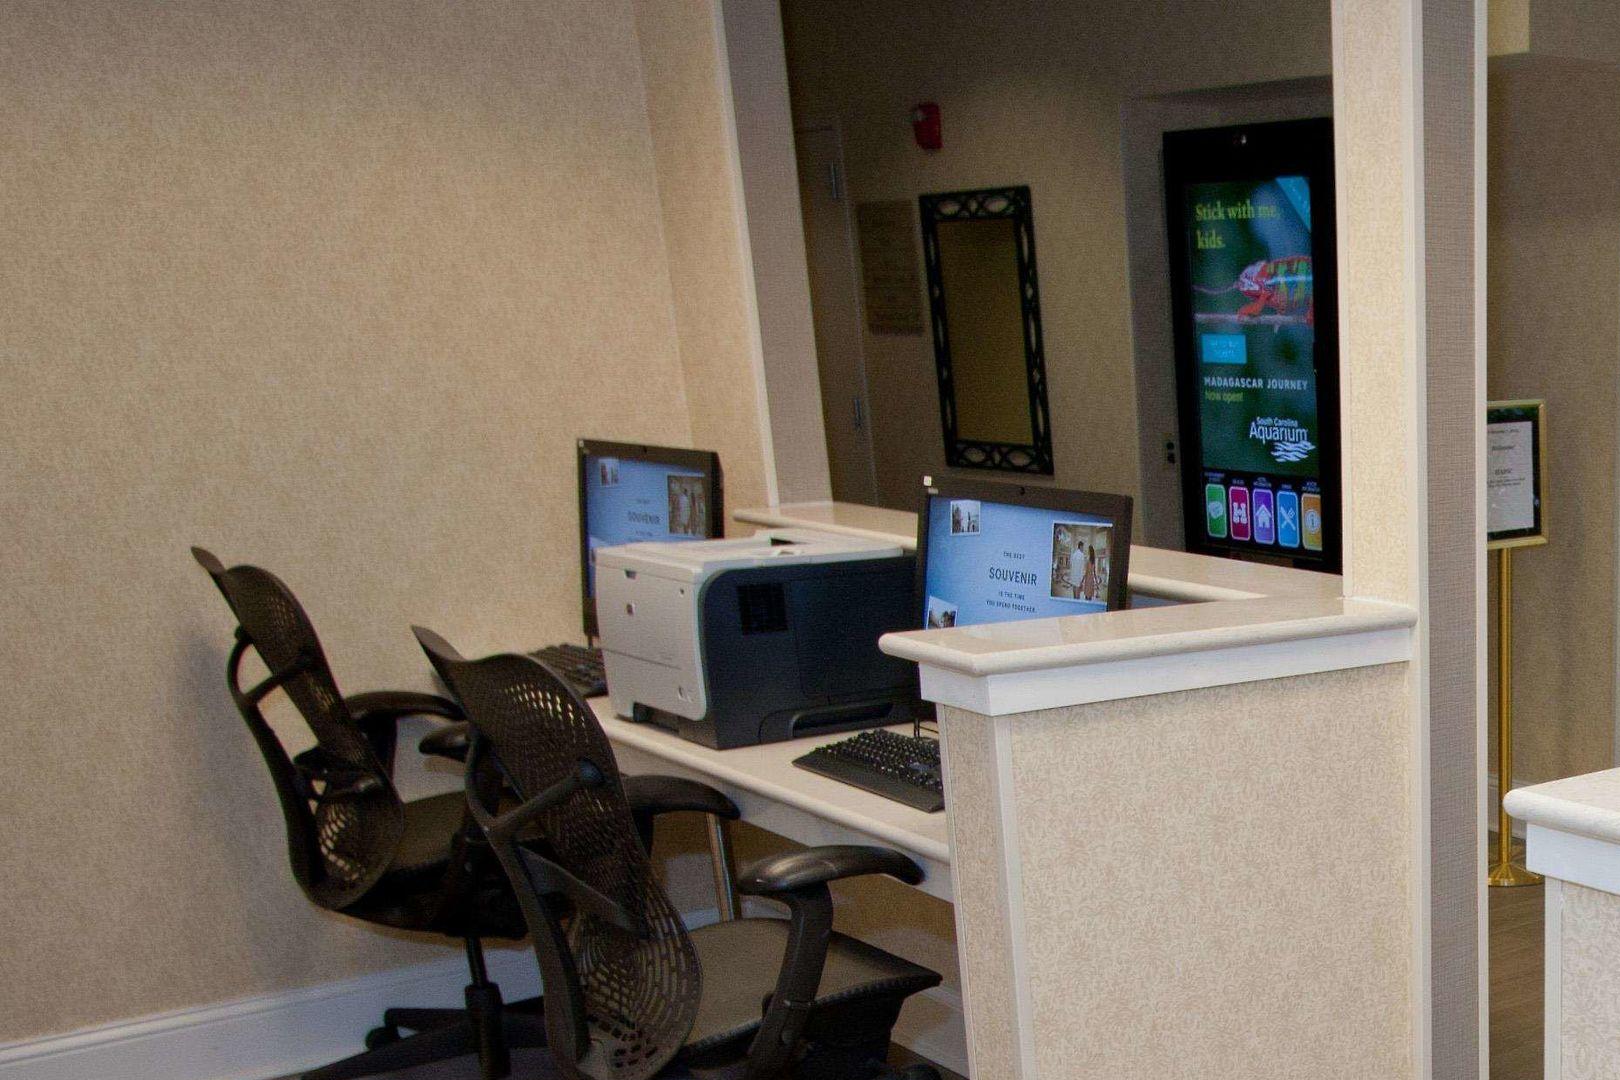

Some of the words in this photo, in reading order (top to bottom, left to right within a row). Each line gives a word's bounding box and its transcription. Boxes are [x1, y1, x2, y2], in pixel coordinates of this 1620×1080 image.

[1195, 200, 1225, 221] Stick
[1227, 199, 1255, 219] with
[1196, 229, 1226, 249] kids.
[1203, 376, 1264, 389] MADAGASCAR
[1266, 379, 1308, 390] JOURNEY
[1256, 416, 1273, 426] South
[1273, 417, 1298, 428] Carolina
[1249, 422, 1308, 445] Aquarium
[989, 567, 1037, 586] SOUVENIR
